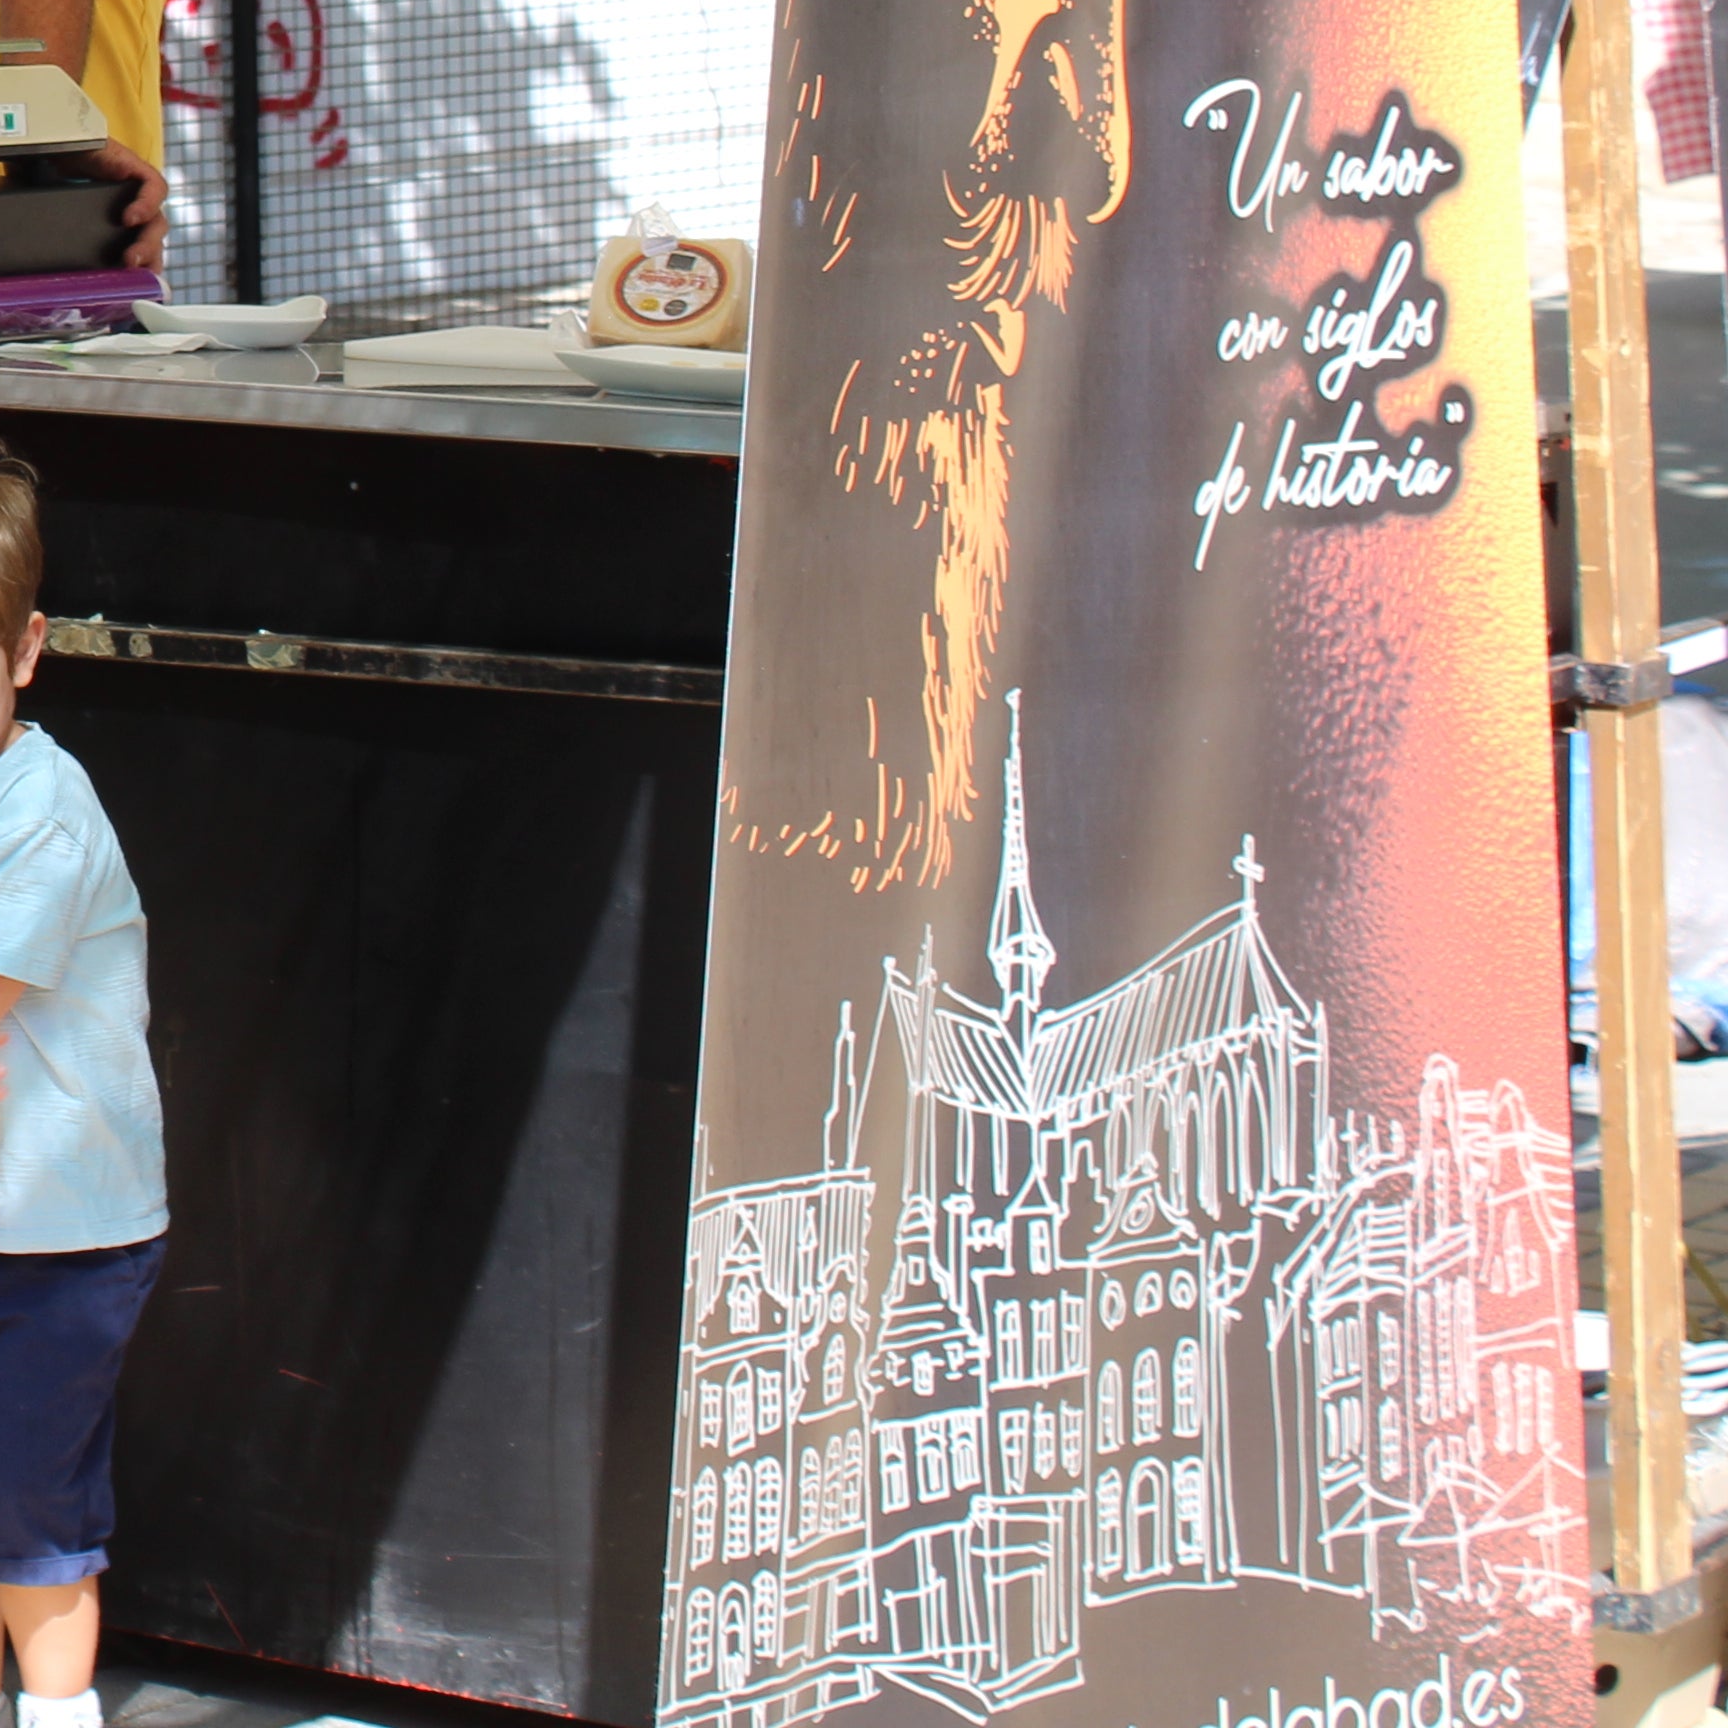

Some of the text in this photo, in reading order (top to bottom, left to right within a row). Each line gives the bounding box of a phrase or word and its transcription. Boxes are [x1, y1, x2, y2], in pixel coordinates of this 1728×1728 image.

[1323, 105, 1455, 202] sabor
[1216, 239, 1438, 402] con siglos
[1193, 420, 1251, 572] de
